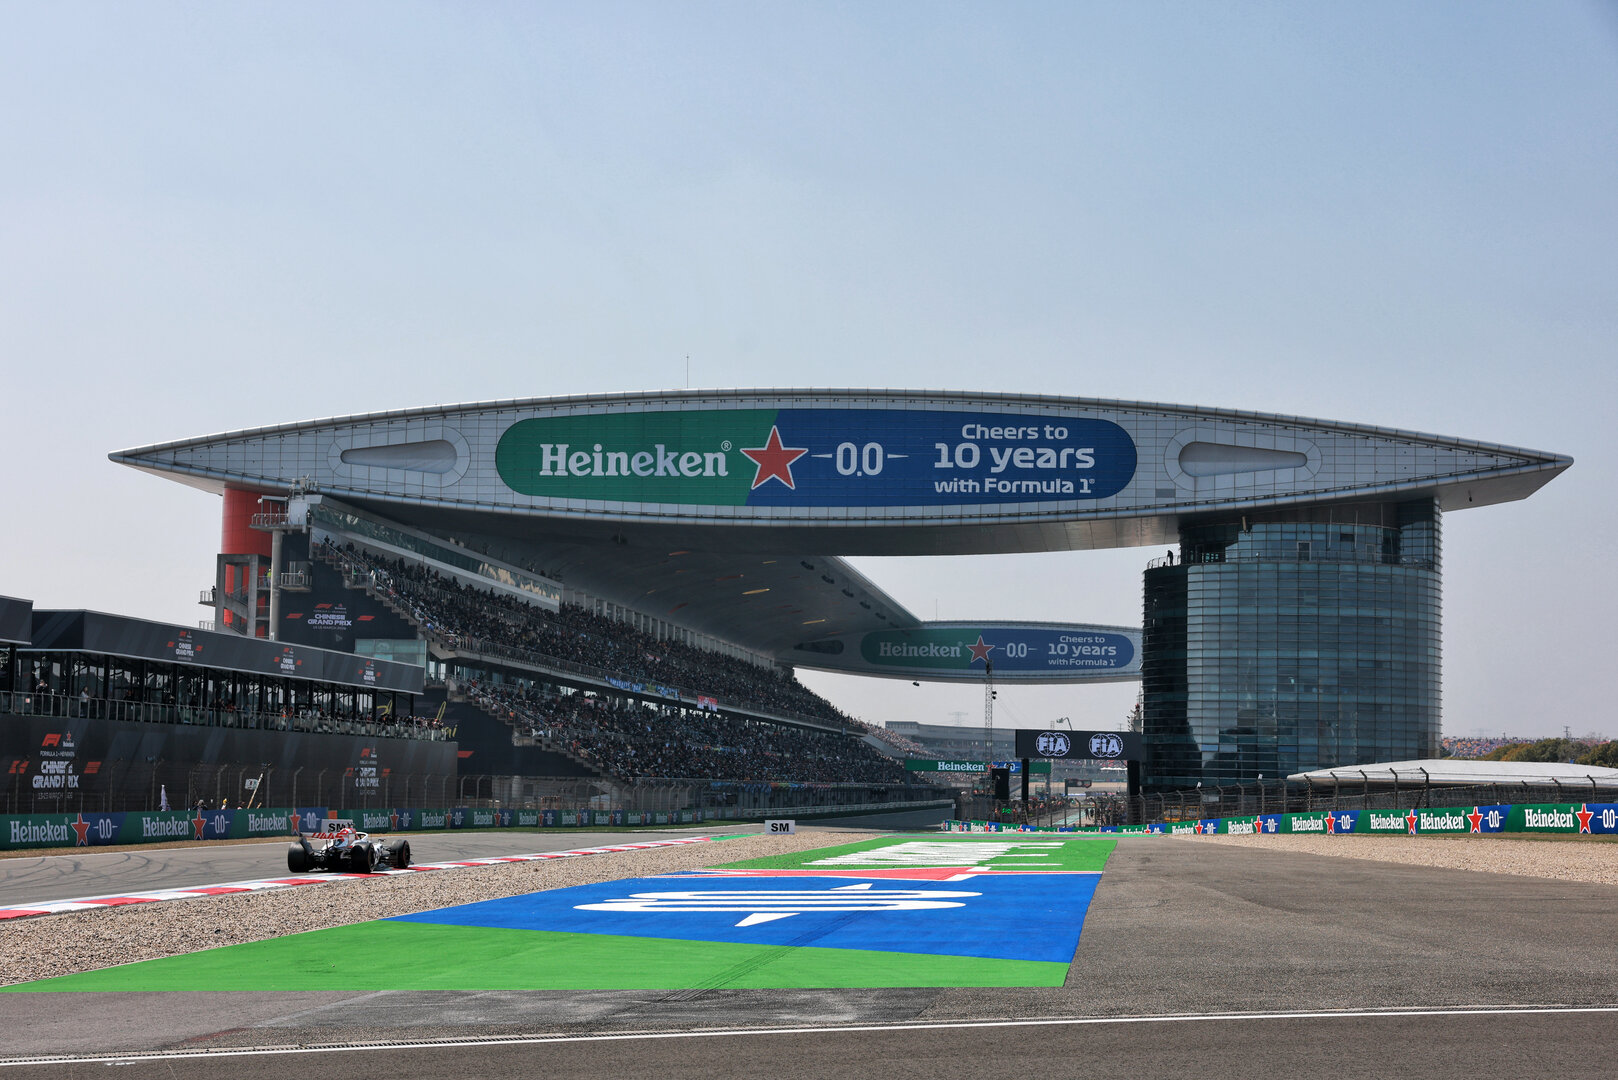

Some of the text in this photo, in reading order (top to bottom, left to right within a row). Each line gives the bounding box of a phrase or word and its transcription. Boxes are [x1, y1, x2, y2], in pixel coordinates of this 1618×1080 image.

[962, 424, 1069, 440] Cheers to
[934, 443, 981, 469] 10
[990, 447, 1096, 473] years
[934, 478, 980, 493] with
[984, 478, 1074, 493] Formula
[1048, 644, 1068, 655] 10
[1072, 646, 1117, 658] years
[1048, 658, 1067, 666] with
[1069, 658, 1108, 666] Formula
[771, 823, 790, 832] SM
